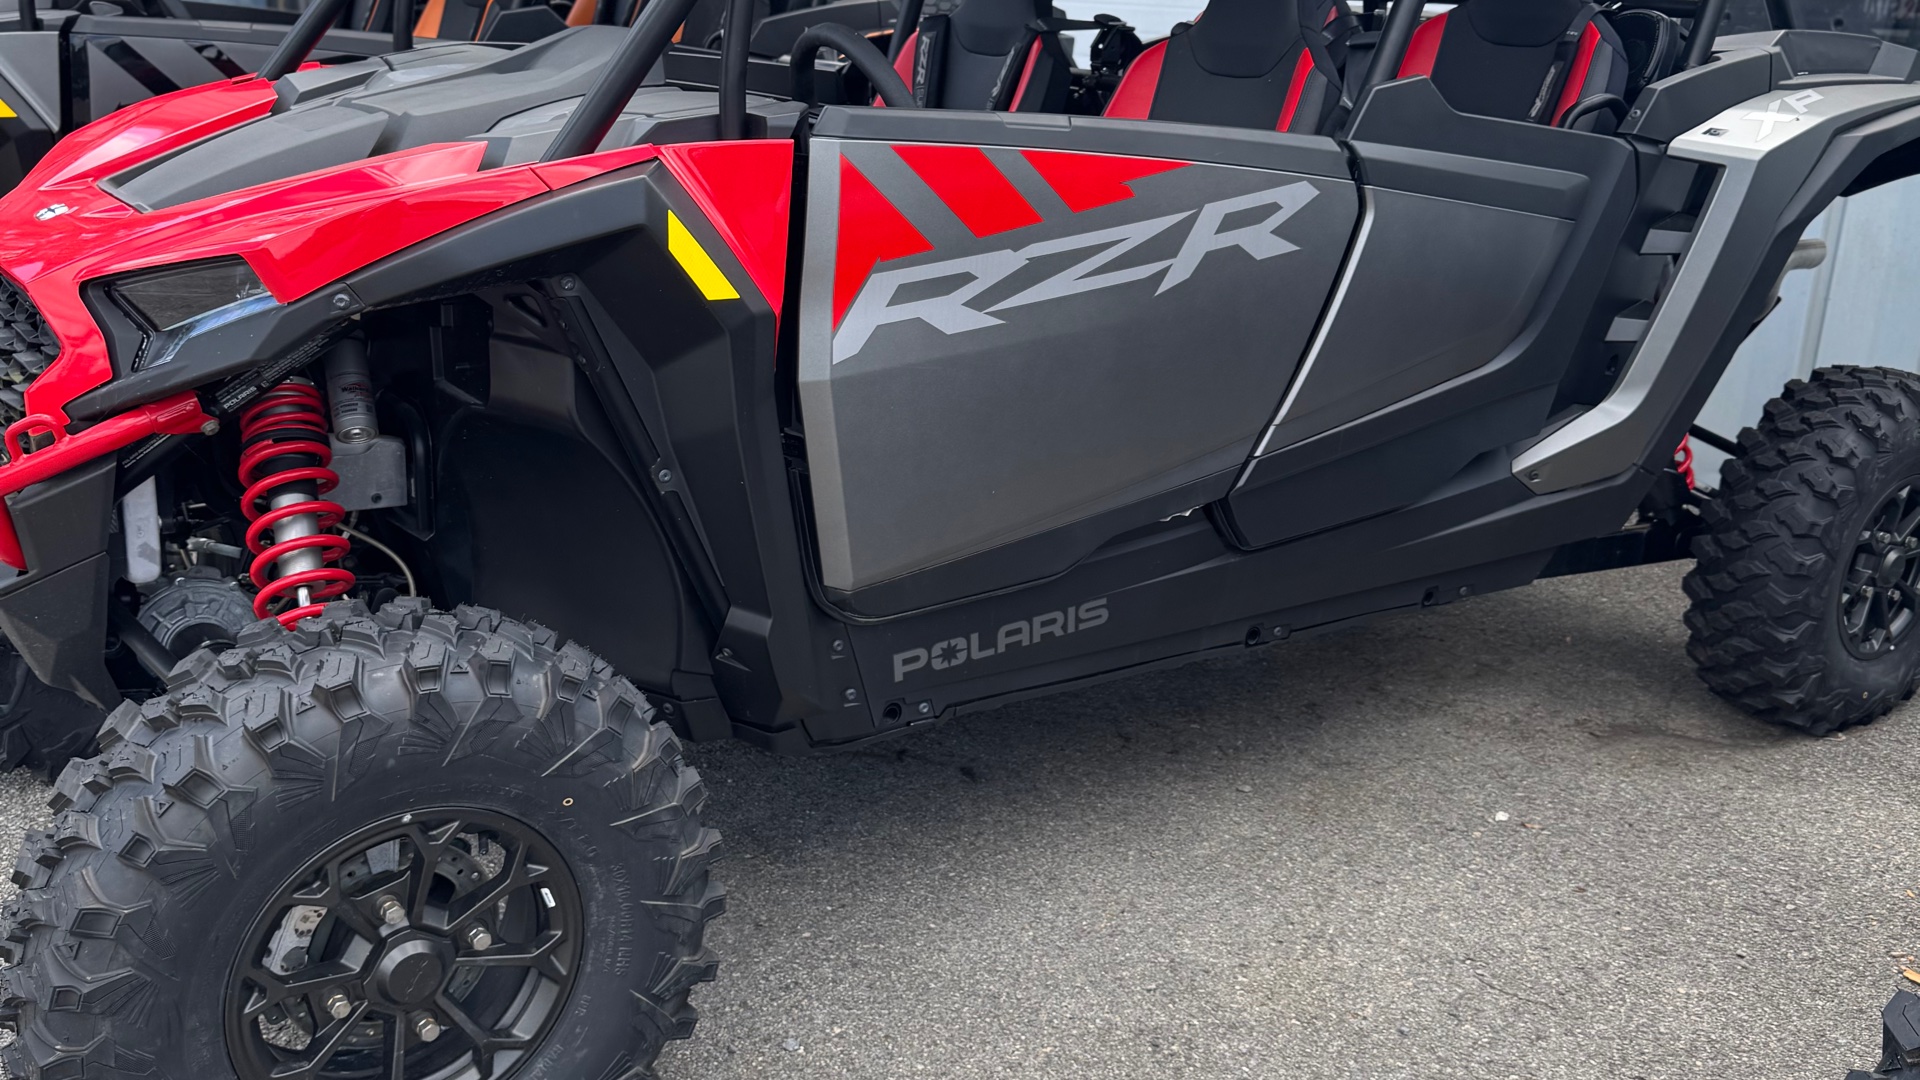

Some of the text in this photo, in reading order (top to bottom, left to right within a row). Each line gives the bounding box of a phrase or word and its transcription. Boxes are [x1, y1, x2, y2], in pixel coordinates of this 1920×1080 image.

[916, 36, 931, 85] RZR
[1741, 89, 1824, 142] XP
[833, 181, 1320, 365] RZR
[223, 386, 257, 409] POLARIS
[893, 598, 1110, 683] POLARIS
